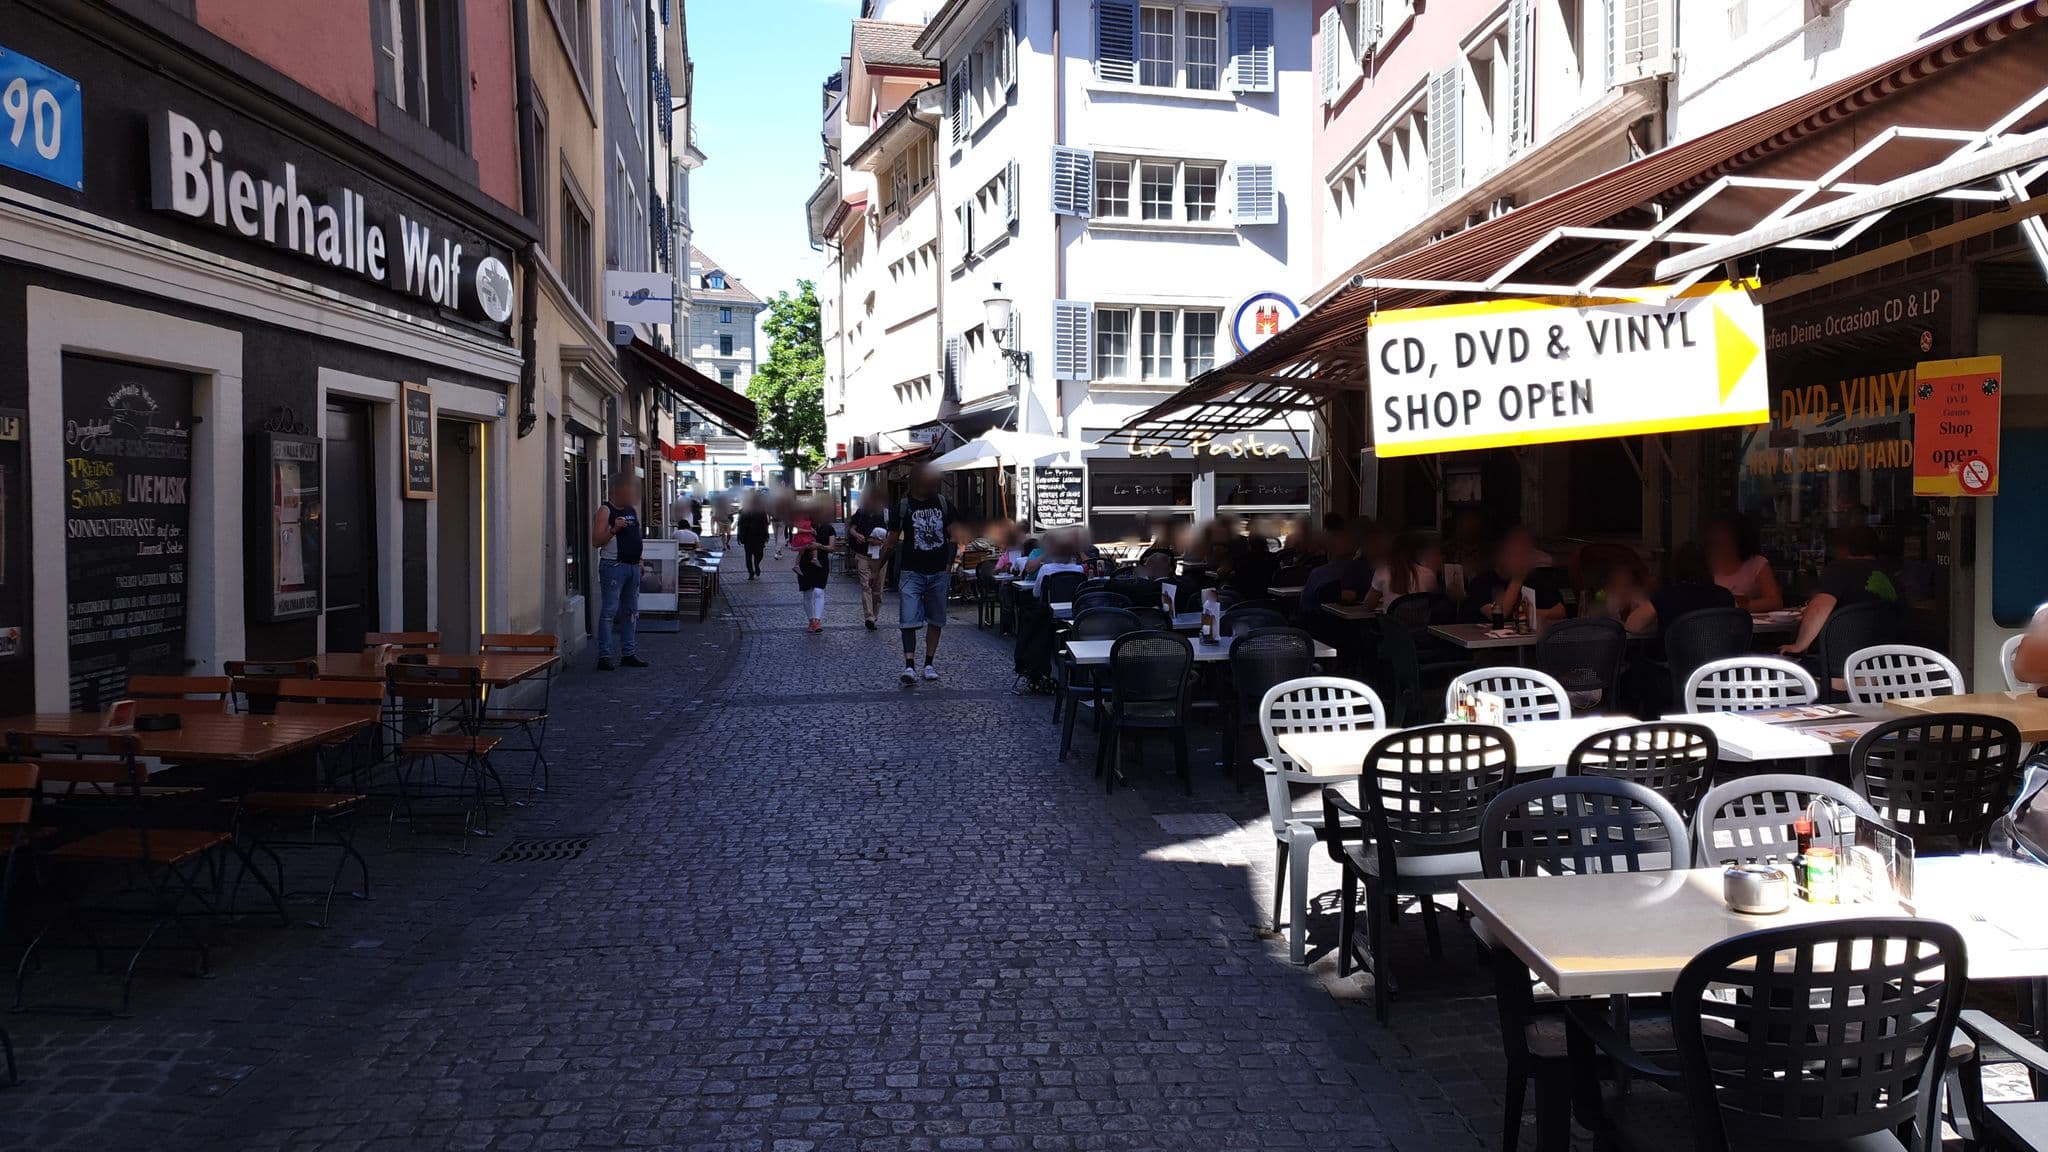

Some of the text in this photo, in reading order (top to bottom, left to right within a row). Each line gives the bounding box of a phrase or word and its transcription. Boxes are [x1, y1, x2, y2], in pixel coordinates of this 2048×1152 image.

[166, 110, 462, 310] Bierhalle Wolf
[1790, 320, 1821, 345] Deine
[1825, 306, 1879, 336] Occasion
[1883, 298, 1903, 324] CD
[1907, 294, 1919, 318] &
[1923, 288, 1941, 315] LP
[1380, 311, 1697, 379] CD, DVD & VINYL
[1947, 395, 1969, 405] DVD
[1950, 383, 1965, 392] CD
[1385, 378, 1595, 433] SHOP OPEN
[1128, 429, 1290, 459] La Pasta
[1939, 421, 1973, 438] Shop
[1747, 449, 1777, 477] NEW
[1799, 445, 1858, 473] SECOND
[1864, 440, 1914, 470] HAND
[127, 474, 187, 505] LIVE MUSIK
[1113, 484, 1170, 496] La Pasta
[67, 518, 156, 539] SONNENTERRASSE
